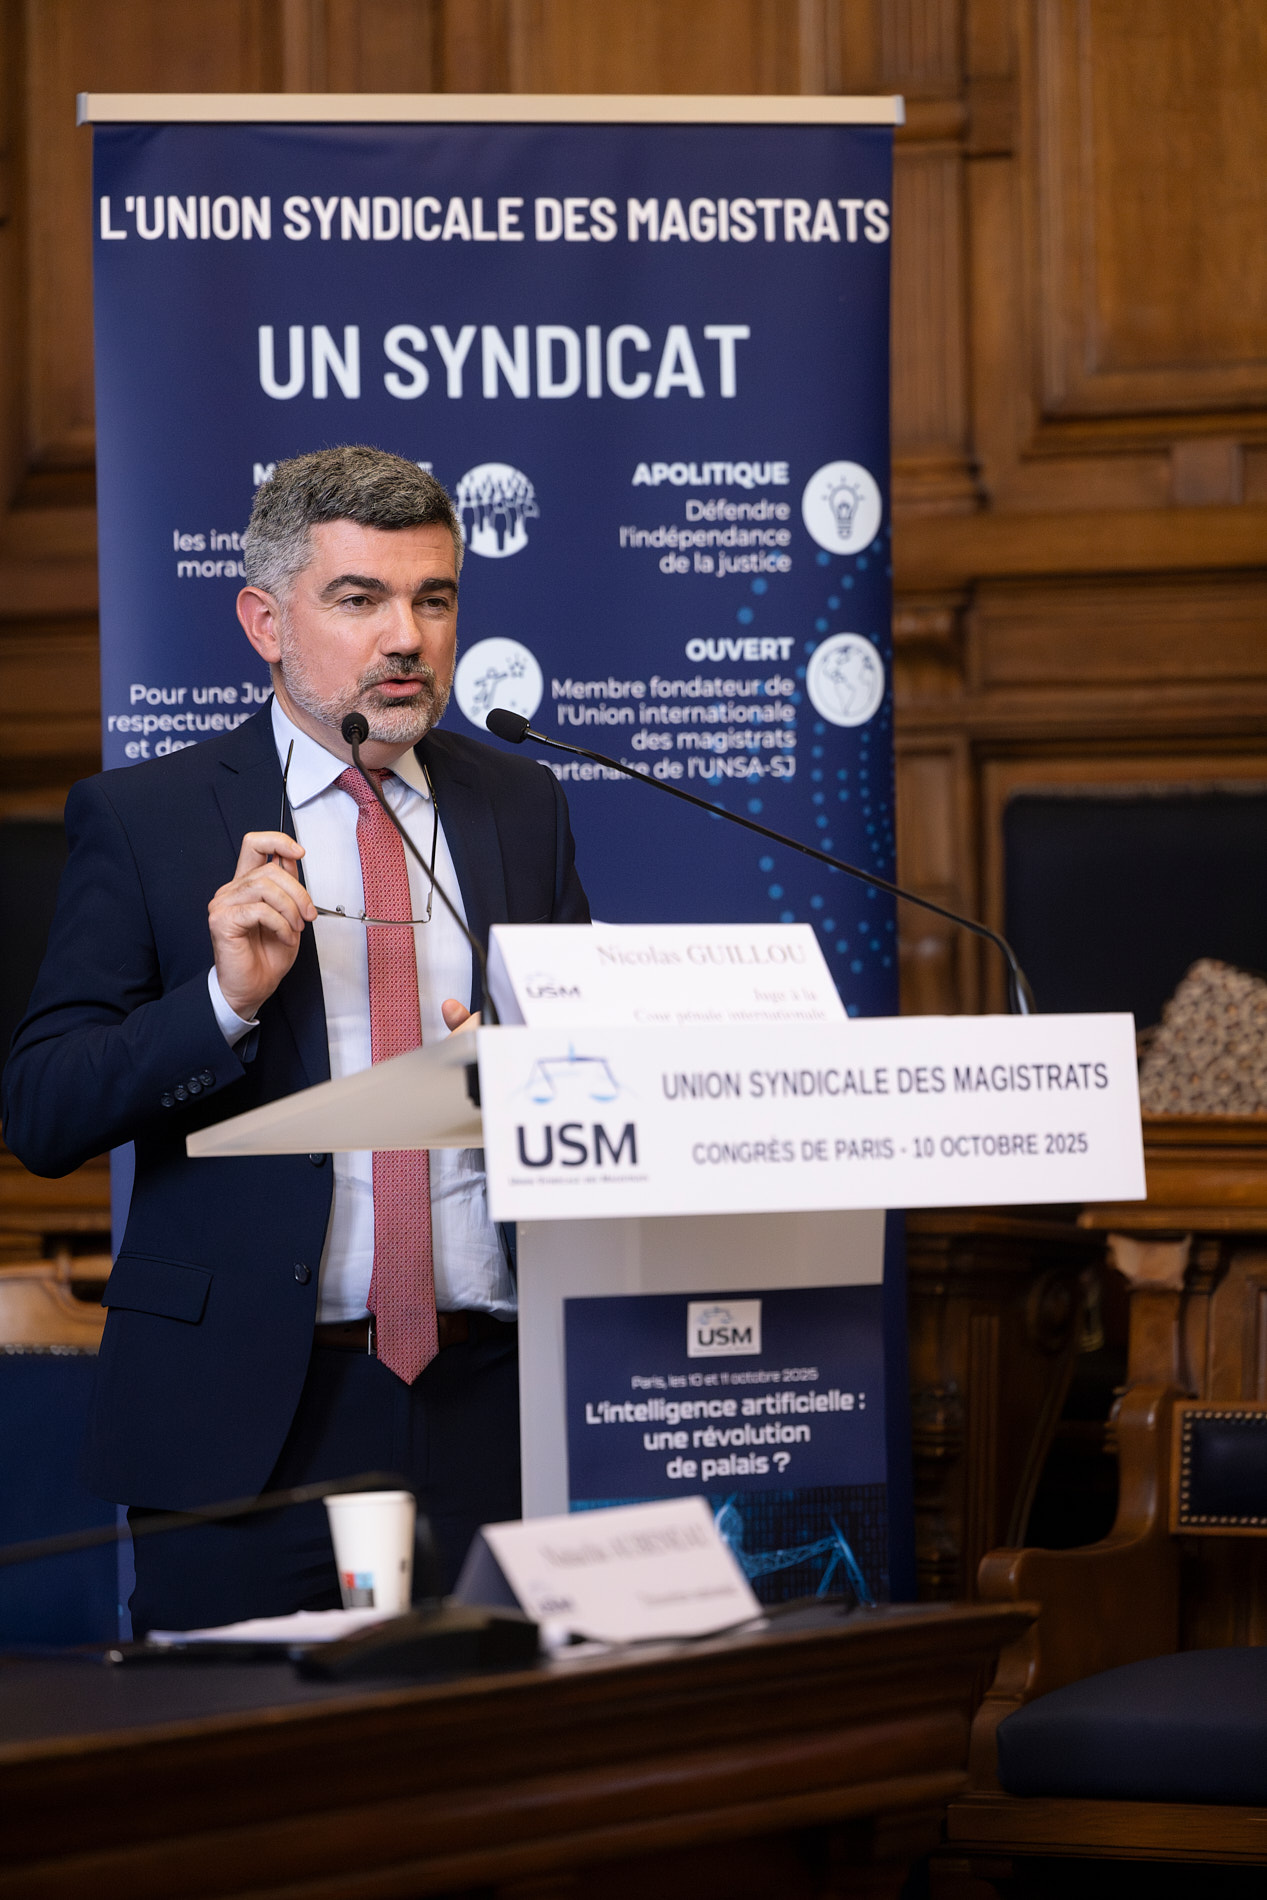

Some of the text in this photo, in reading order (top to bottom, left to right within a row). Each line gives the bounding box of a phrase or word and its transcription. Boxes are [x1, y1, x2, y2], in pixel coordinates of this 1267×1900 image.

[100, 195, 890, 244] L'UNION SYNDICALE DES MAGISTRATS
[258, 324, 750, 400] UN SYNDICAT
[632, 461, 790, 489] APOLITIQUE
[686, 498, 791, 521] Défendre
[173, 528, 206, 551] les
[620, 525, 791, 551] l'indépendance
[177, 560, 247, 578] morau
[659, 550, 792, 578] de la justice
[686, 637, 794, 661] OUVERT
[129, 683, 187, 705] Pour
[192, 686, 238, 704] une
[552, 675, 794, 699] Membre fondateur de
[558, 702, 795, 726] l'Union internationale
[125, 739, 150, 759] et
[632, 727, 797, 753] des magistrats
[652, 758, 684, 781] de
[688, 755, 795, 779] l'UNSA-SJ
[596, 945, 807, 966] Nicolas GUILLOU
[662, 1062, 1109, 1101] UNION SYNDICALE DES MAGISTRATS
[516, 1122, 638, 1168] USM
[692, 1139, 795, 1166] CONGRÈS
[801, 1140, 829, 1162] DE
[835, 1137, 895, 1161] PARIS
[913, 1137, 934, 1158] 10
[940, 1134, 1040, 1158] OCTOBRE
[1045, 1132, 1089, 1155] 2025
[697, 1327, 753, 1347] USM
[632, 1375, 667, 1390] Paris,
[668, 1374, 687, 1388] les
[704, 1373, 719, 1386] et
[730, 1370, 780, 1385] octobre
[586, 1398, 737, 1426] L'intelligence
[741, 1390, 854, 1415] artificielle
[644, 1422, 811, 1450] une révolution
[667, 1452, 791, 1481] de palais ?
